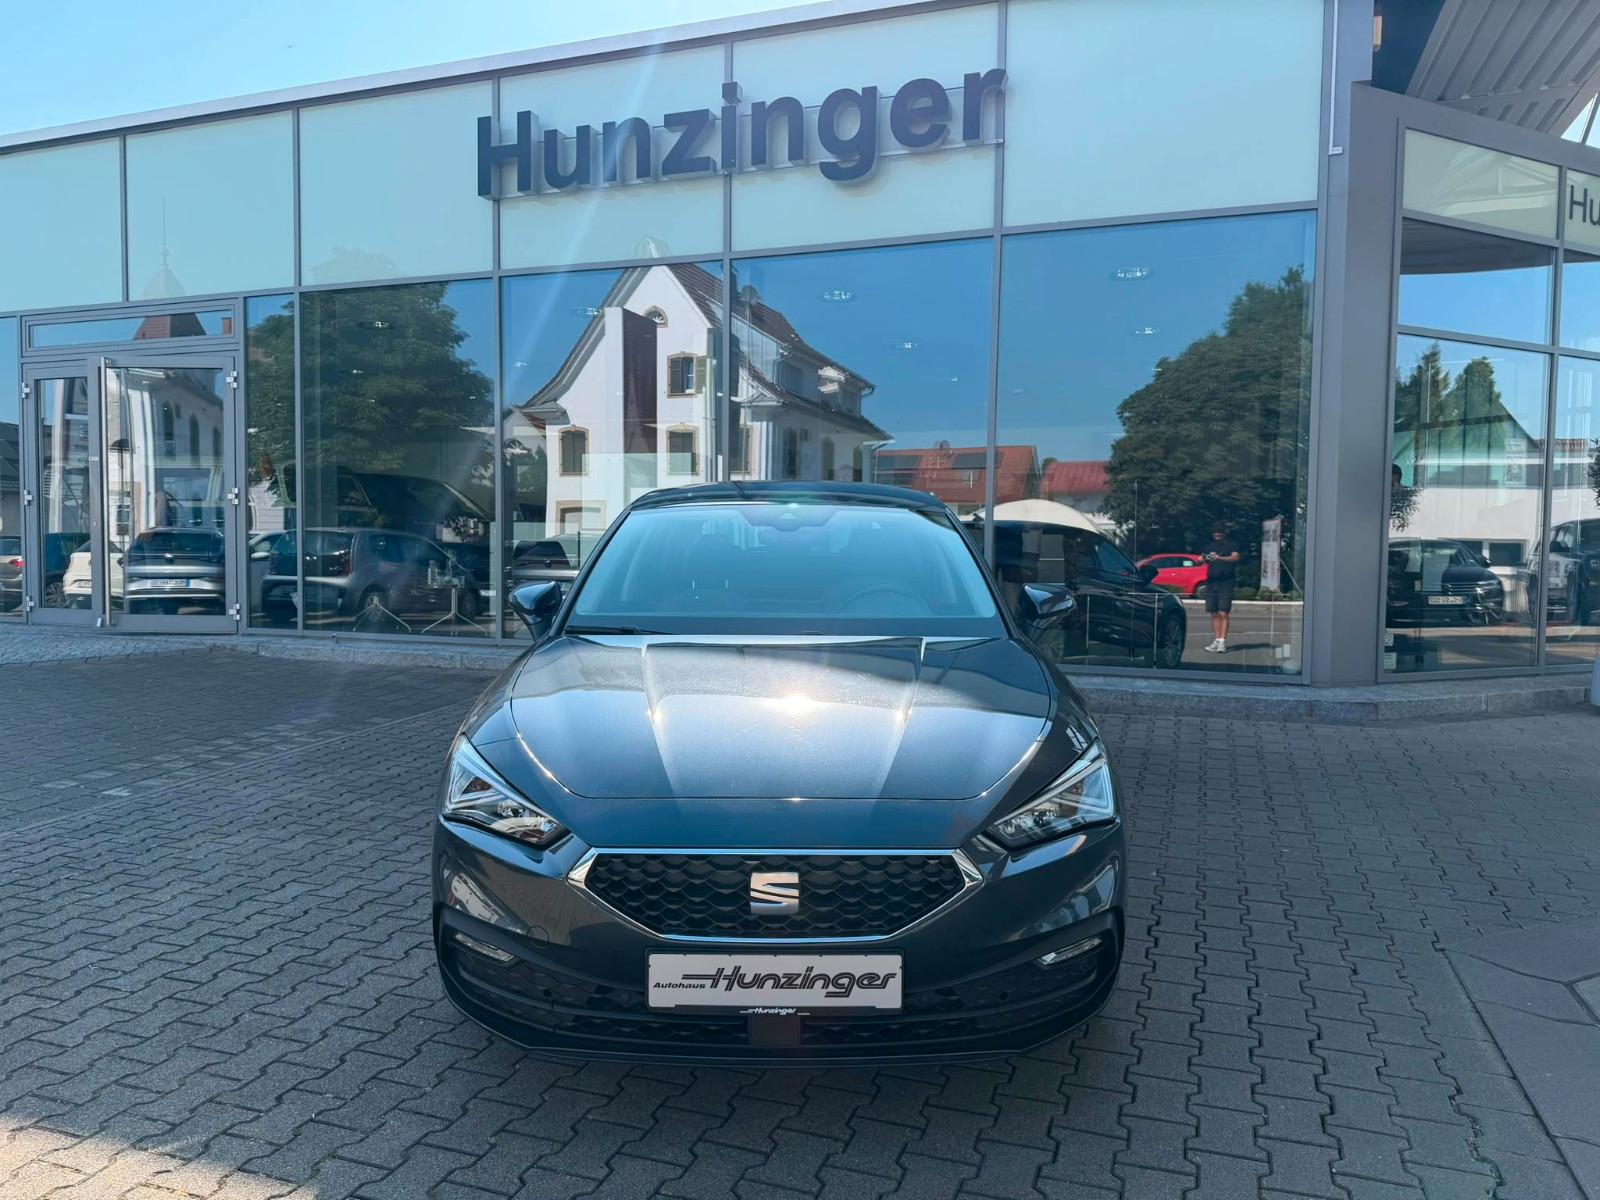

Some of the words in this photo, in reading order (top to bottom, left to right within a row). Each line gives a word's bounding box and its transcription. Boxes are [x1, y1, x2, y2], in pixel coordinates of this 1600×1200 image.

[477, 67, 1007, 200] Hunzinger
[653, 981, 706, 990] Autohaus
[681, 965, 897, 998] Hunzinger
[748, 1007, 797, 1015] Hunzinger
